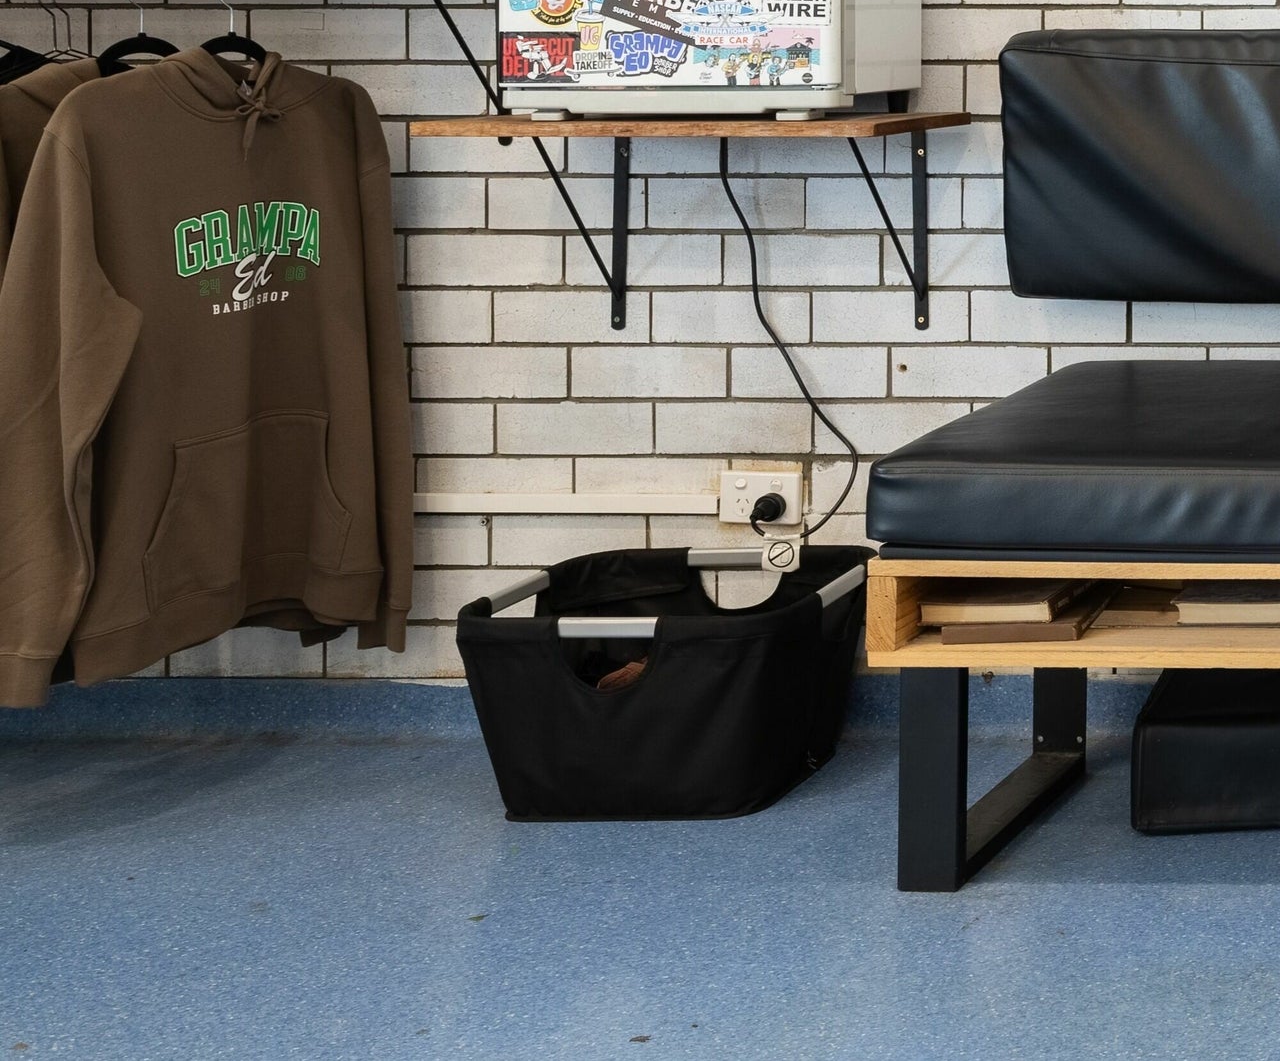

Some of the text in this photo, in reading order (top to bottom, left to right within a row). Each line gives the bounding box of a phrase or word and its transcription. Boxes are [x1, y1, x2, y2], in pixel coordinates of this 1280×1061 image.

[613, 6, 672, 32] SUPPLY EDUCATION
[767, 3, 826, 17] WIRE
[580, 25, 600, 46] UG
[700, 36, 748, 44] RACE CAR
[625, 52, 649, 72] ED
[174, 201, 320, 277] GRAMPA
[232, 251, 276, 301] Ed
[200, 278, 221, 296] 24
[257, 291, 290, 305] SHOP
